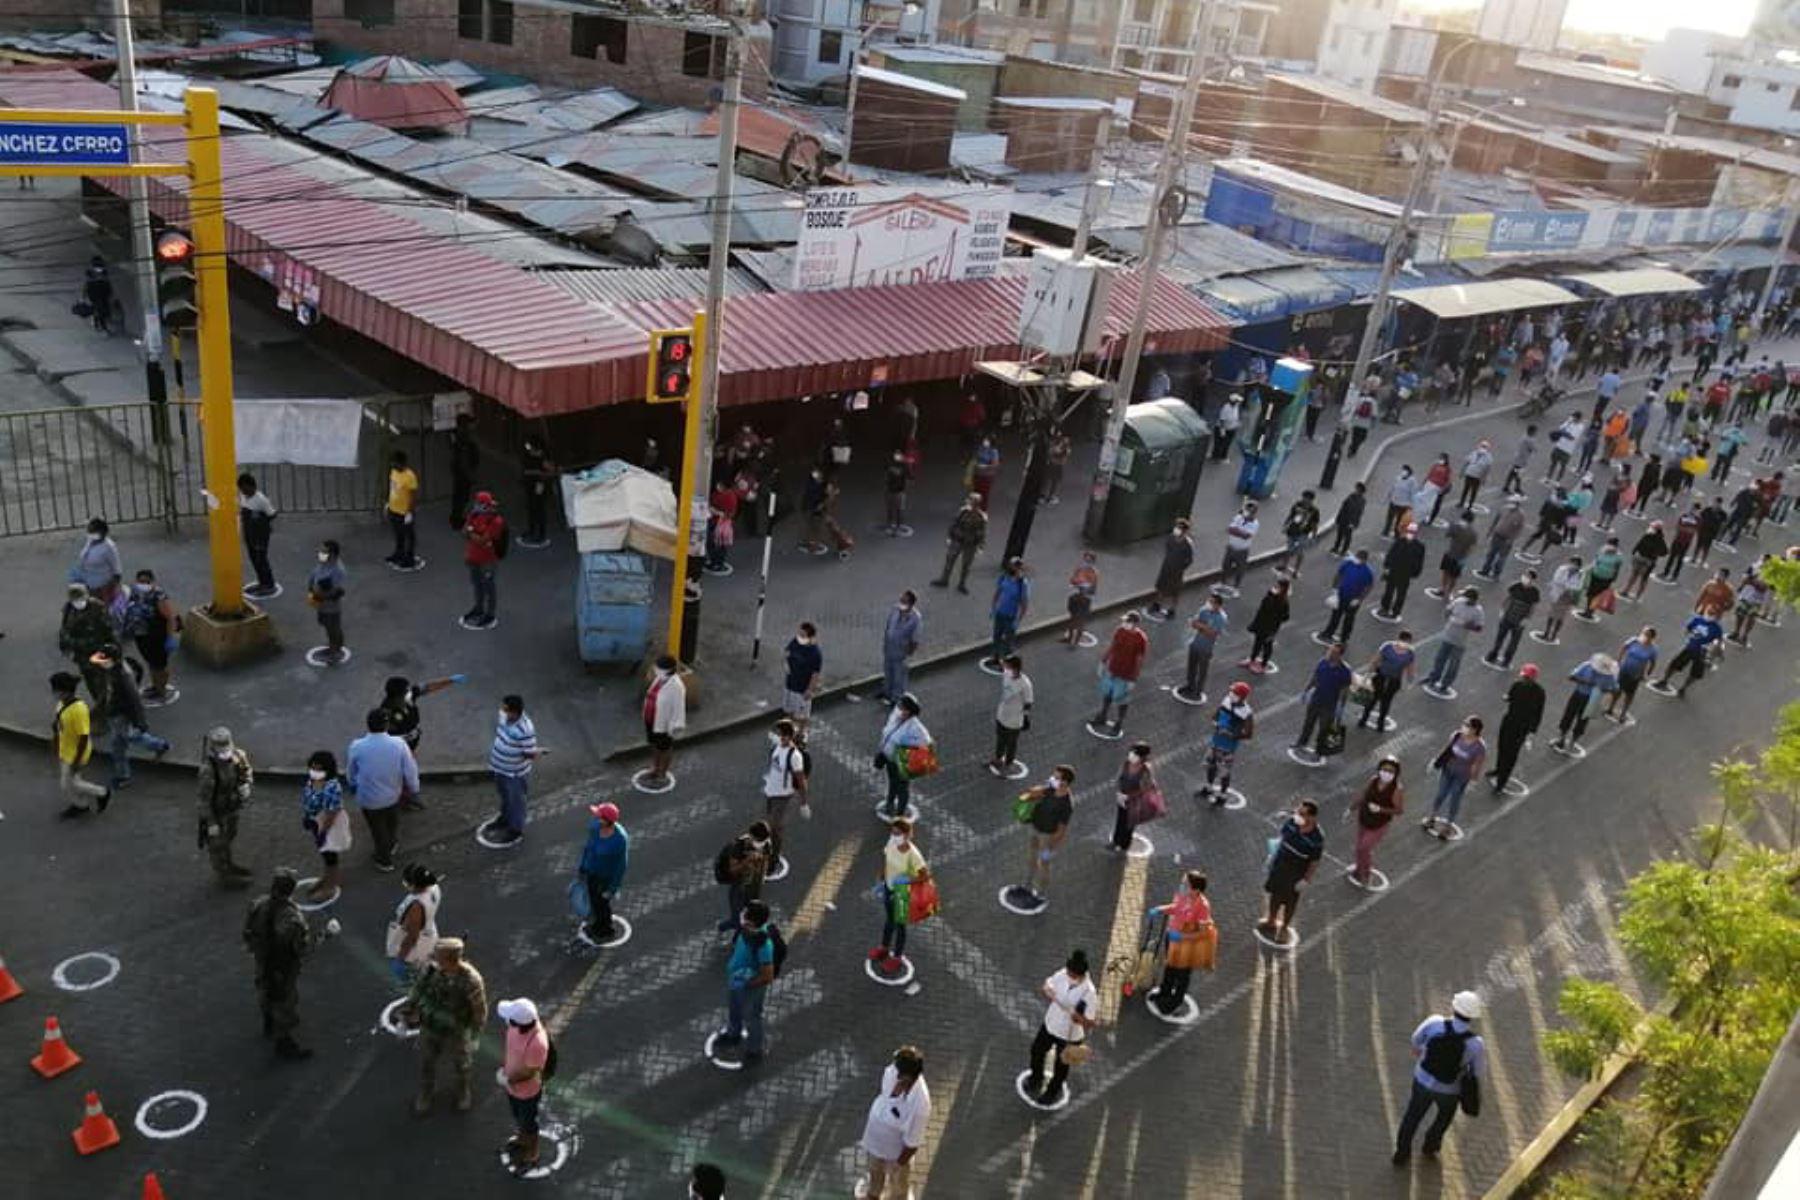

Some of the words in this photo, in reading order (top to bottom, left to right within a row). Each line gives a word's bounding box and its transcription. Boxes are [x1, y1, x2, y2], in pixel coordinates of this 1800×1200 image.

[0, 134, 59, 152] NCHEZ
[62, 136, 123, 153] CERRO
[807, 211, 846, 229] BOSQUE
